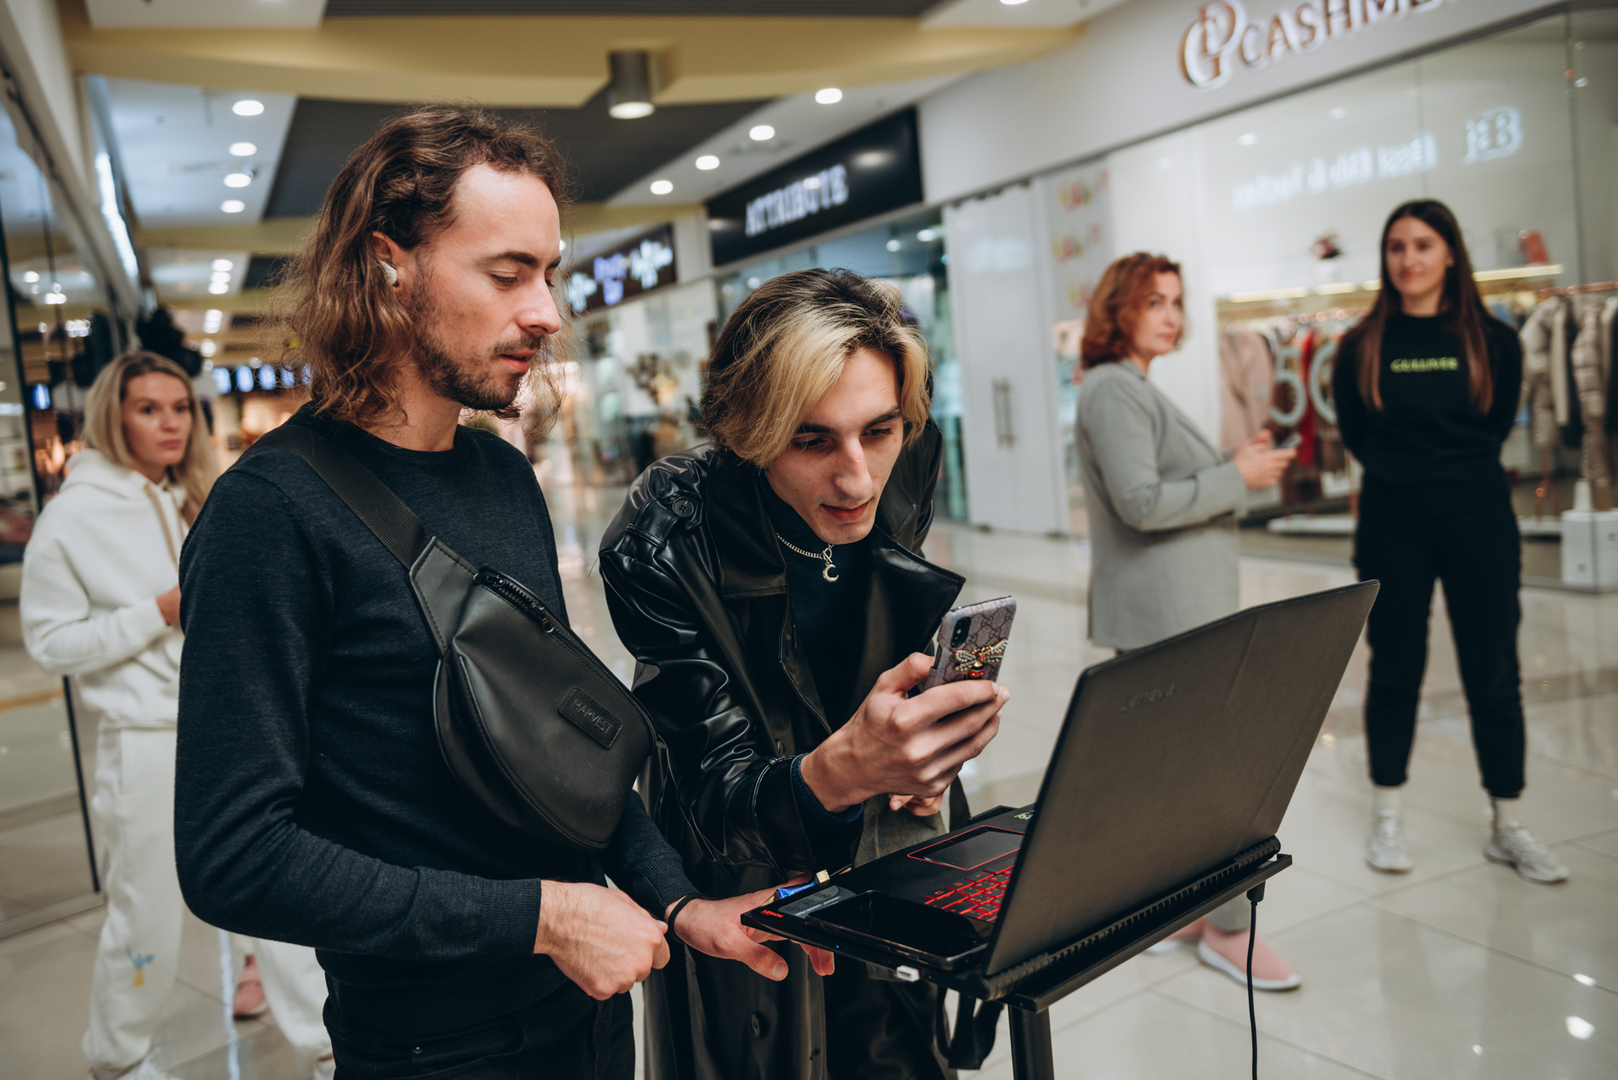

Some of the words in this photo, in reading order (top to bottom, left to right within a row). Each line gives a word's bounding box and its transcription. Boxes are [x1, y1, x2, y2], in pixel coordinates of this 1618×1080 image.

[745, 164, 849, 237] ATTRIBUTE
[1120, 683, 1176, 712] Lenovo
[571, 699, 614, 735] HARVEST
